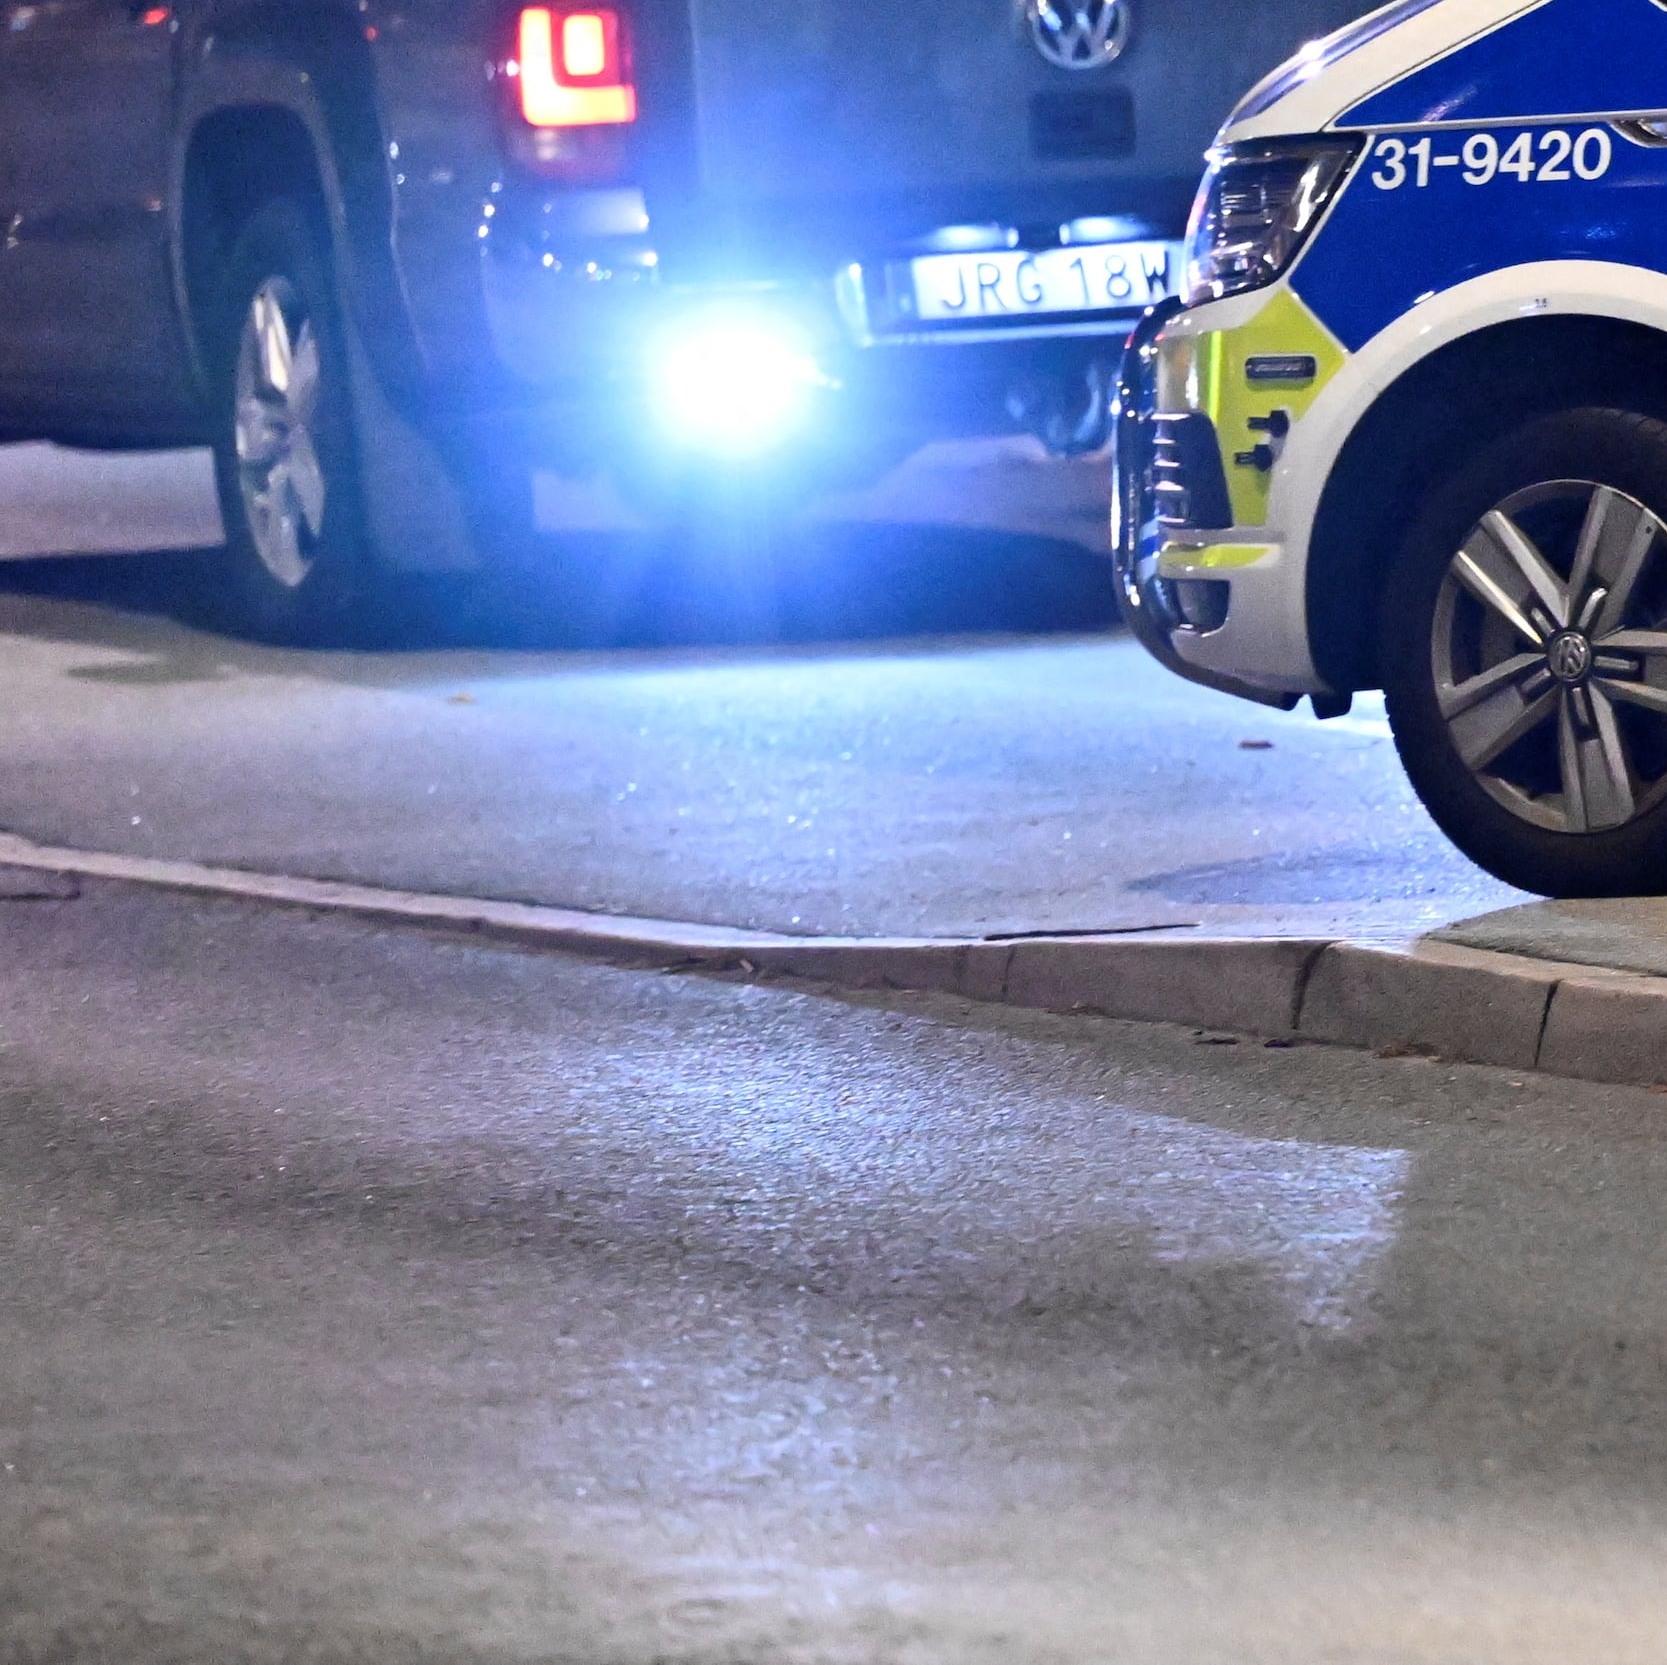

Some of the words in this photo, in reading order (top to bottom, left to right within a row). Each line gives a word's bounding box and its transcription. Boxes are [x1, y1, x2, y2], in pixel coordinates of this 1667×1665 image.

[1371, 128, 1612, 190] 31-9420
[942, 257, 1043, 310] JRG
[1069, 248, 1171, 305] 18W
